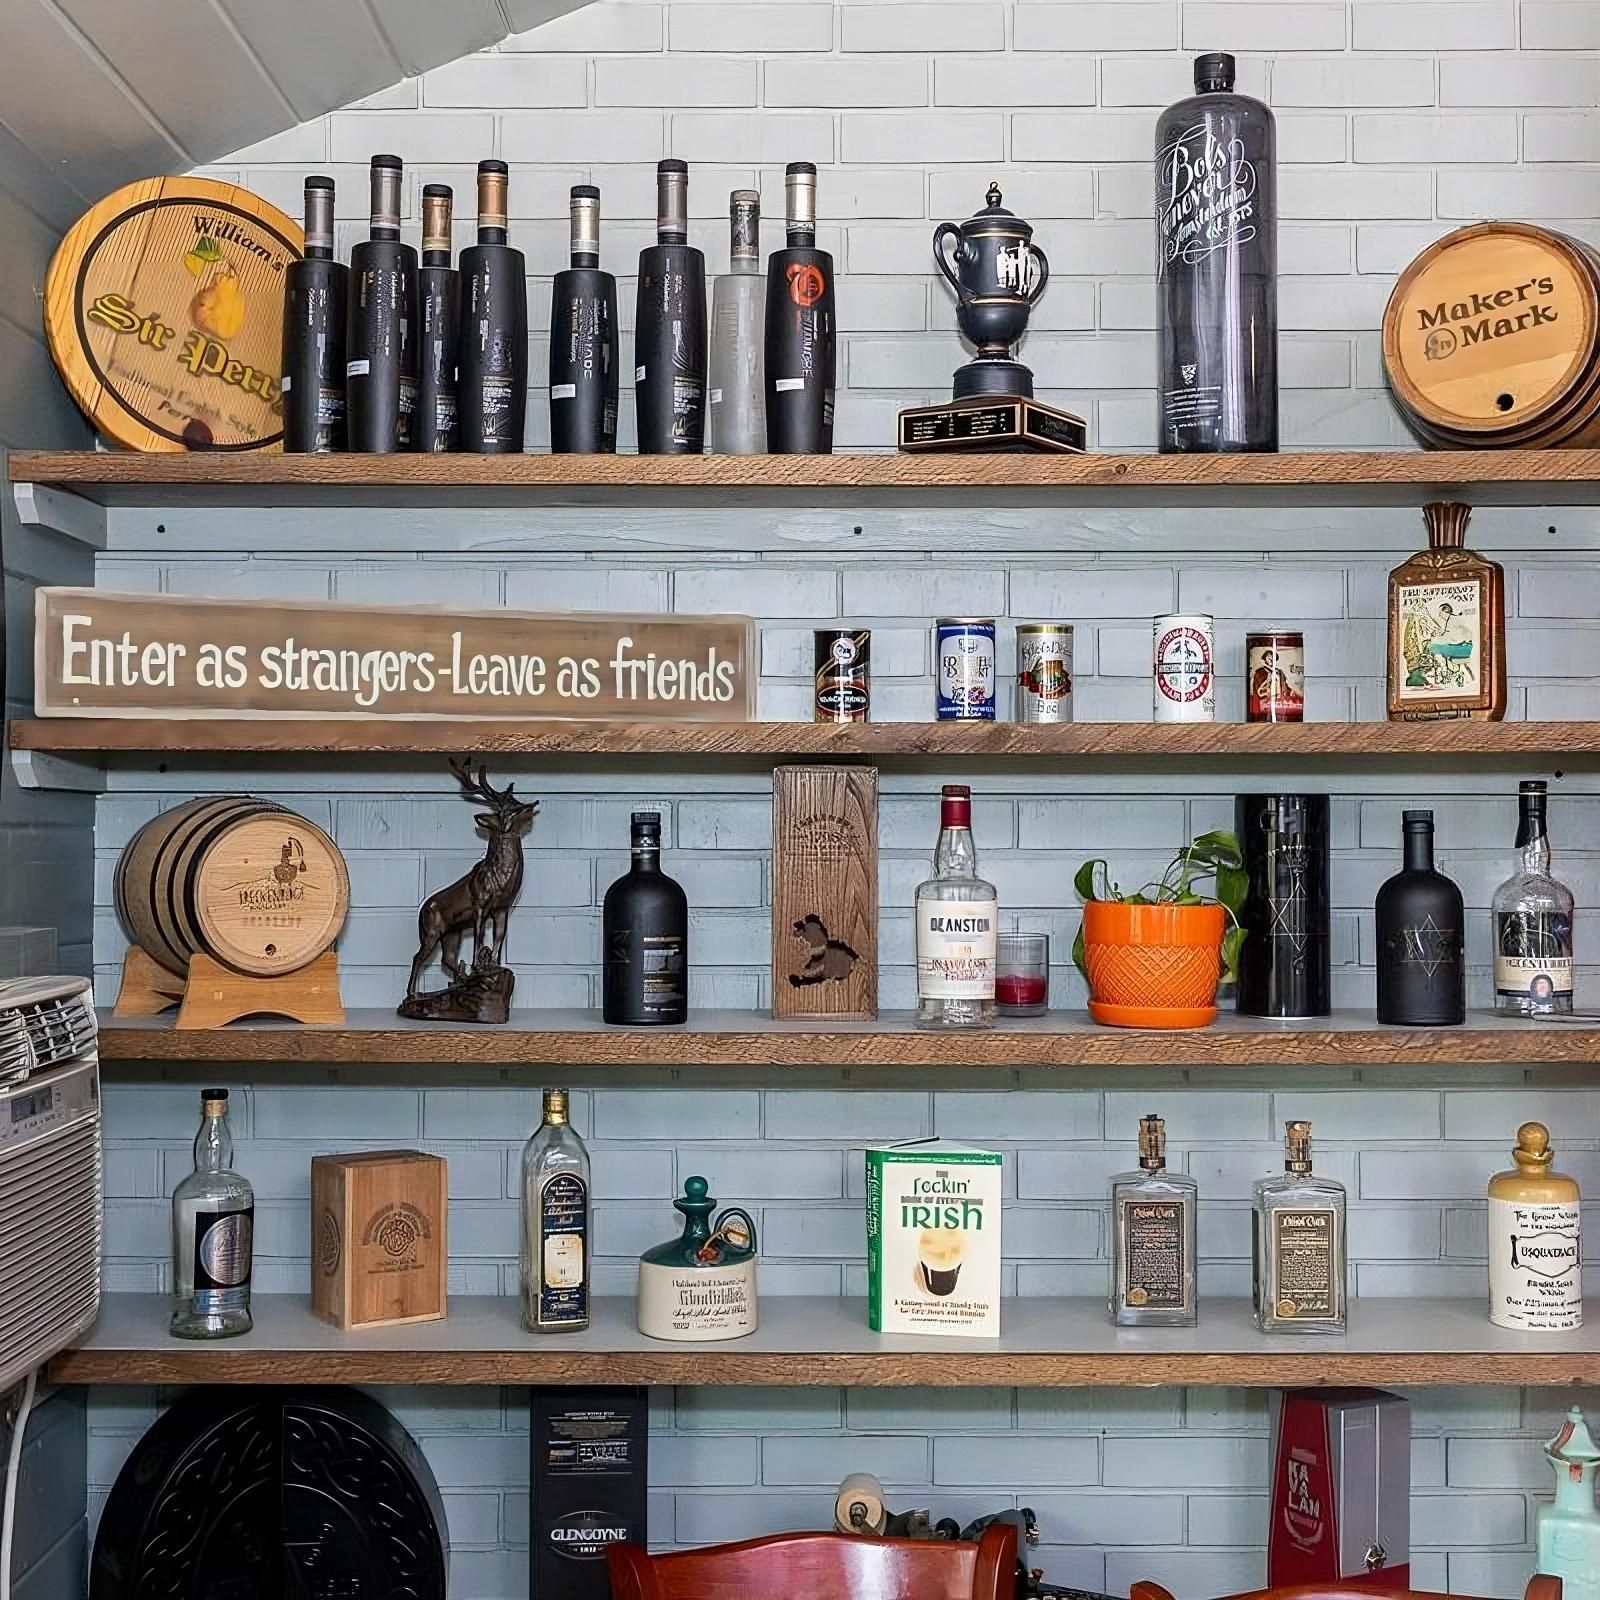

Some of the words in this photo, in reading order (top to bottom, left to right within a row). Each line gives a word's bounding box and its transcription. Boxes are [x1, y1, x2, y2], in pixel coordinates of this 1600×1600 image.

[1162, 122, 1227, 200] Bols
[192, 215, 285, 272] William's
[88, 293, 176, 350] Sir
[1417, 276, 1554, 330] Maker's
[1460, 304, 1559, 347] Mark
[158, 400, 192, 421] Perr
[62, 614, 187, 687] Enter
[196, 643, 248, 689] as
[556, 656, 602, 698] as
[609, 636, 736, 703] friends
[550, 1528, 627, 1541] GLENGOYNE
